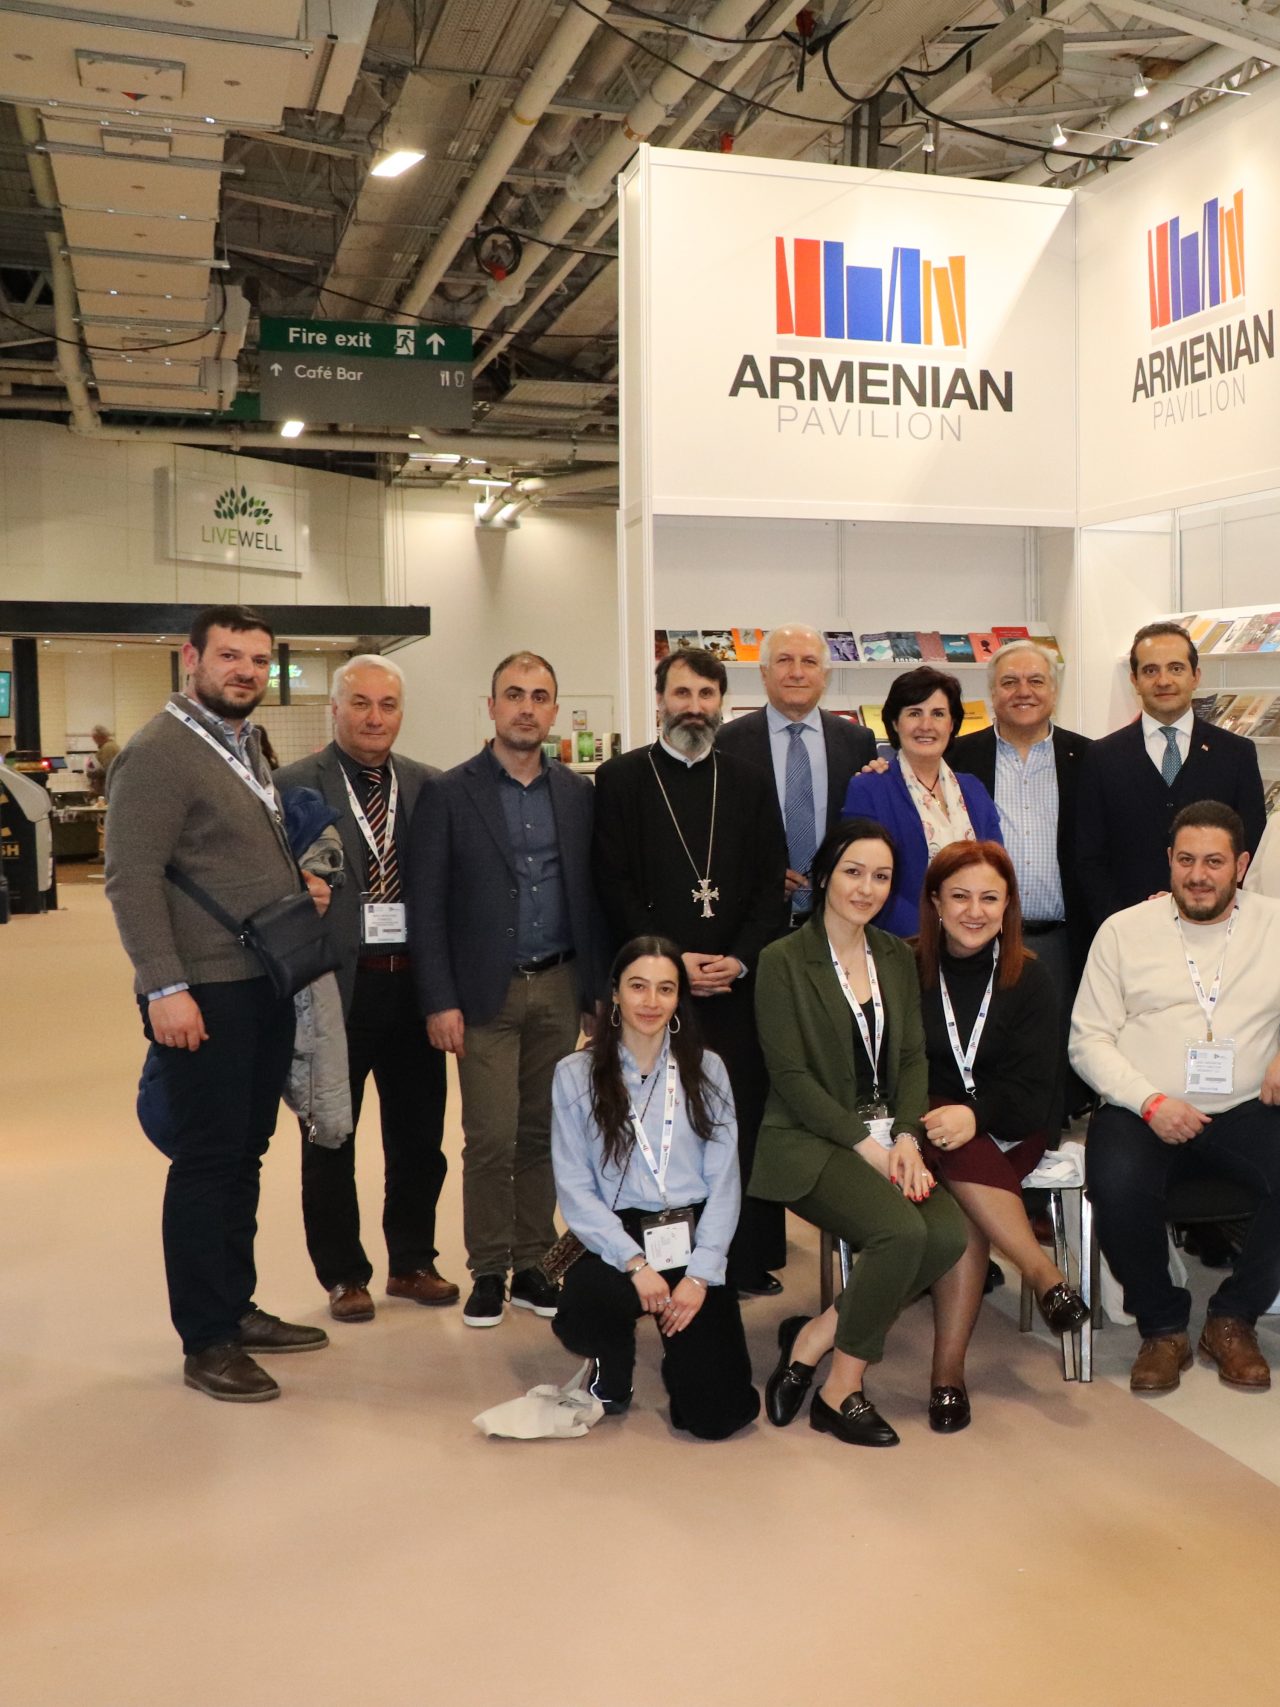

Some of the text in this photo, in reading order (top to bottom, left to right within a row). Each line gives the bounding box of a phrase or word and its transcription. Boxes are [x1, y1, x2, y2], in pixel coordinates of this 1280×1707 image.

[288, 327, 373, 349] Fire exit
[1132, 309, 1275, 403] ARMENIAN
[293, 364, 364, 381] Café Bar
[728, 354, 1013, 412] ARMENIAN
[1153, 372, 1246, 430] PAVILION
[777, 404, 963, 442] PAVILION
[201, 524, 283, 552] LIVEWELL
